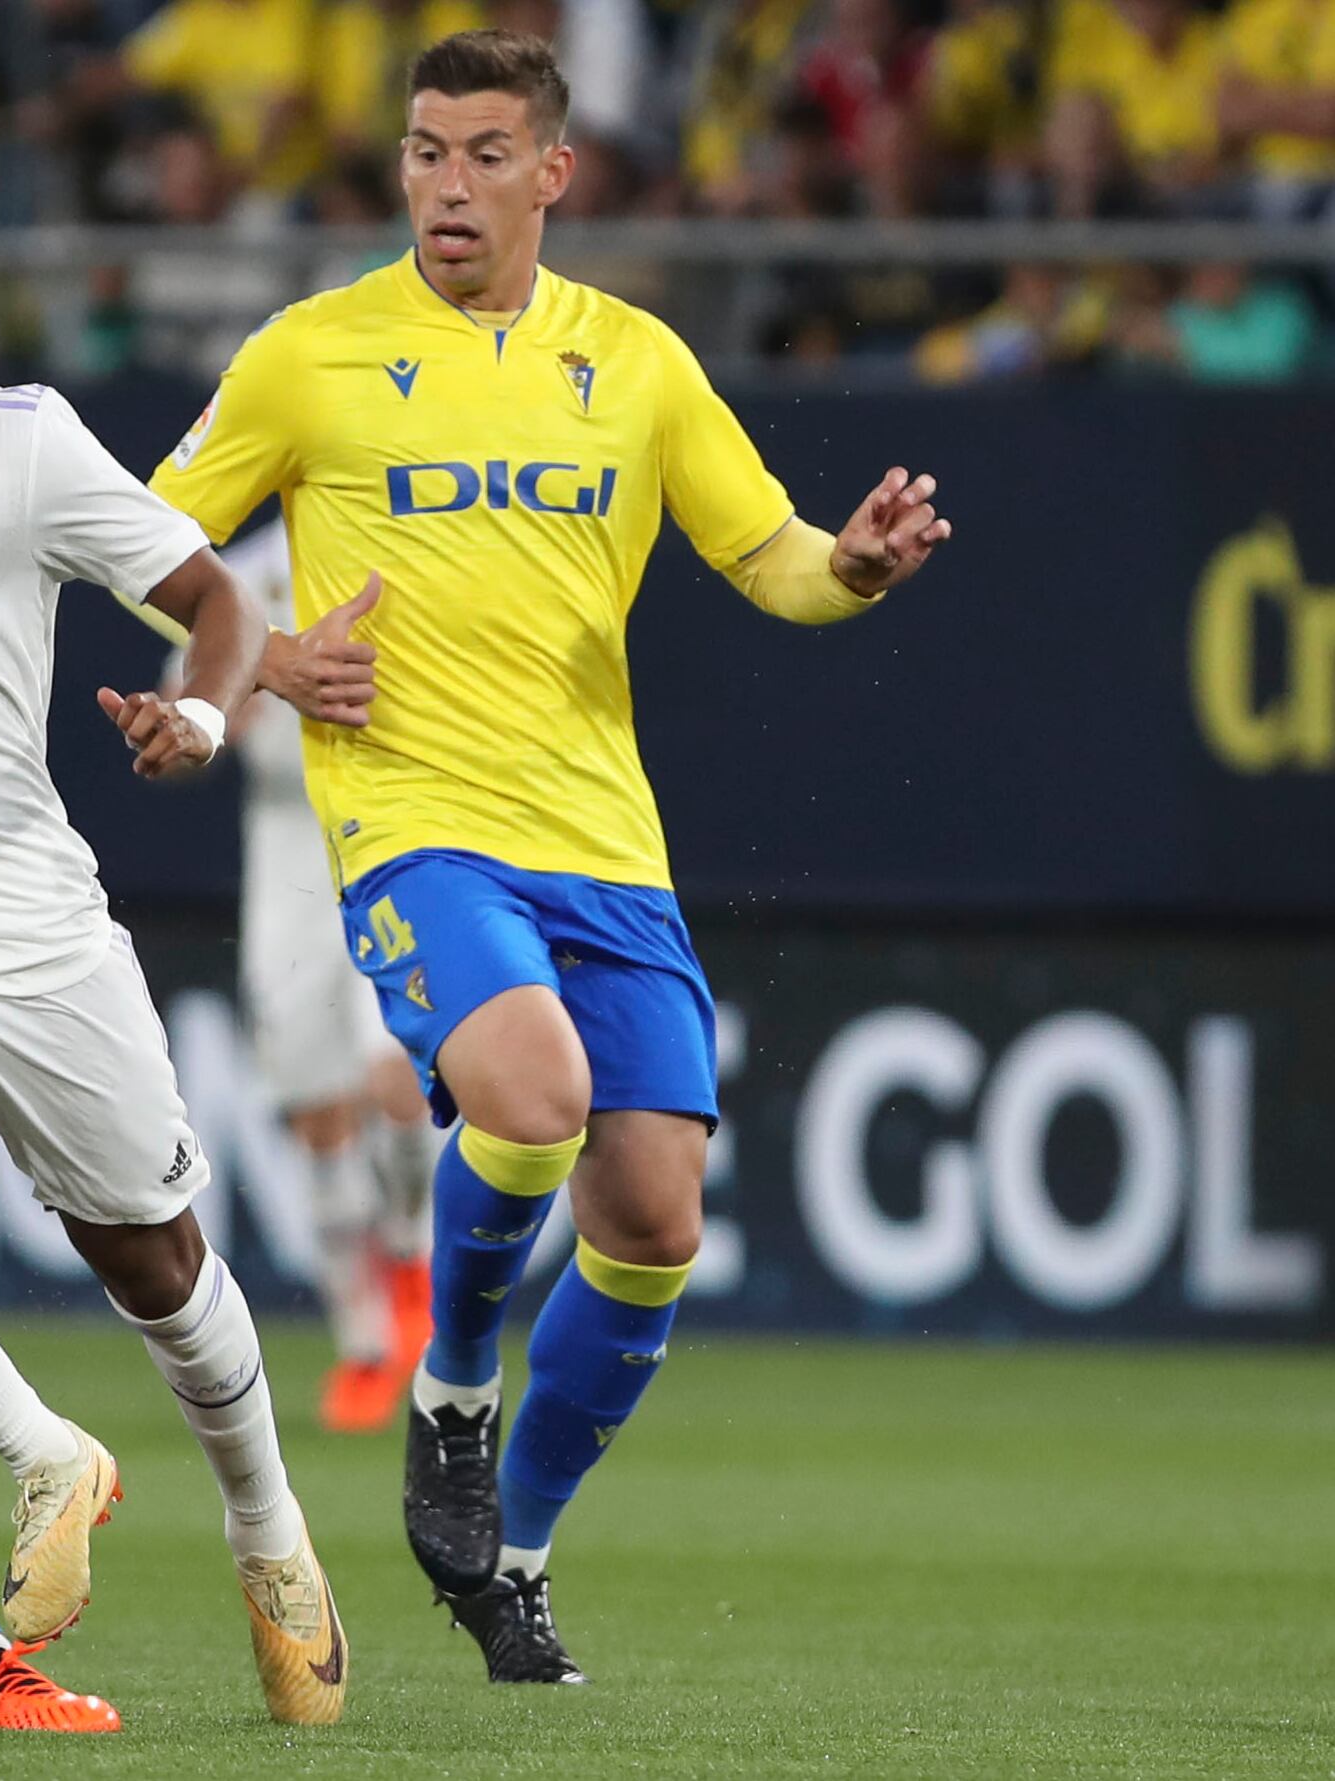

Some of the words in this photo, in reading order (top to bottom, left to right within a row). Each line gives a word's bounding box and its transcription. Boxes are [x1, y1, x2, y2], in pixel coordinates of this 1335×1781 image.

[385, 459, 617, 518] DIGI
[368, 894, 417, 965] 4
[793, 1005, 1322, 1311] GOL
